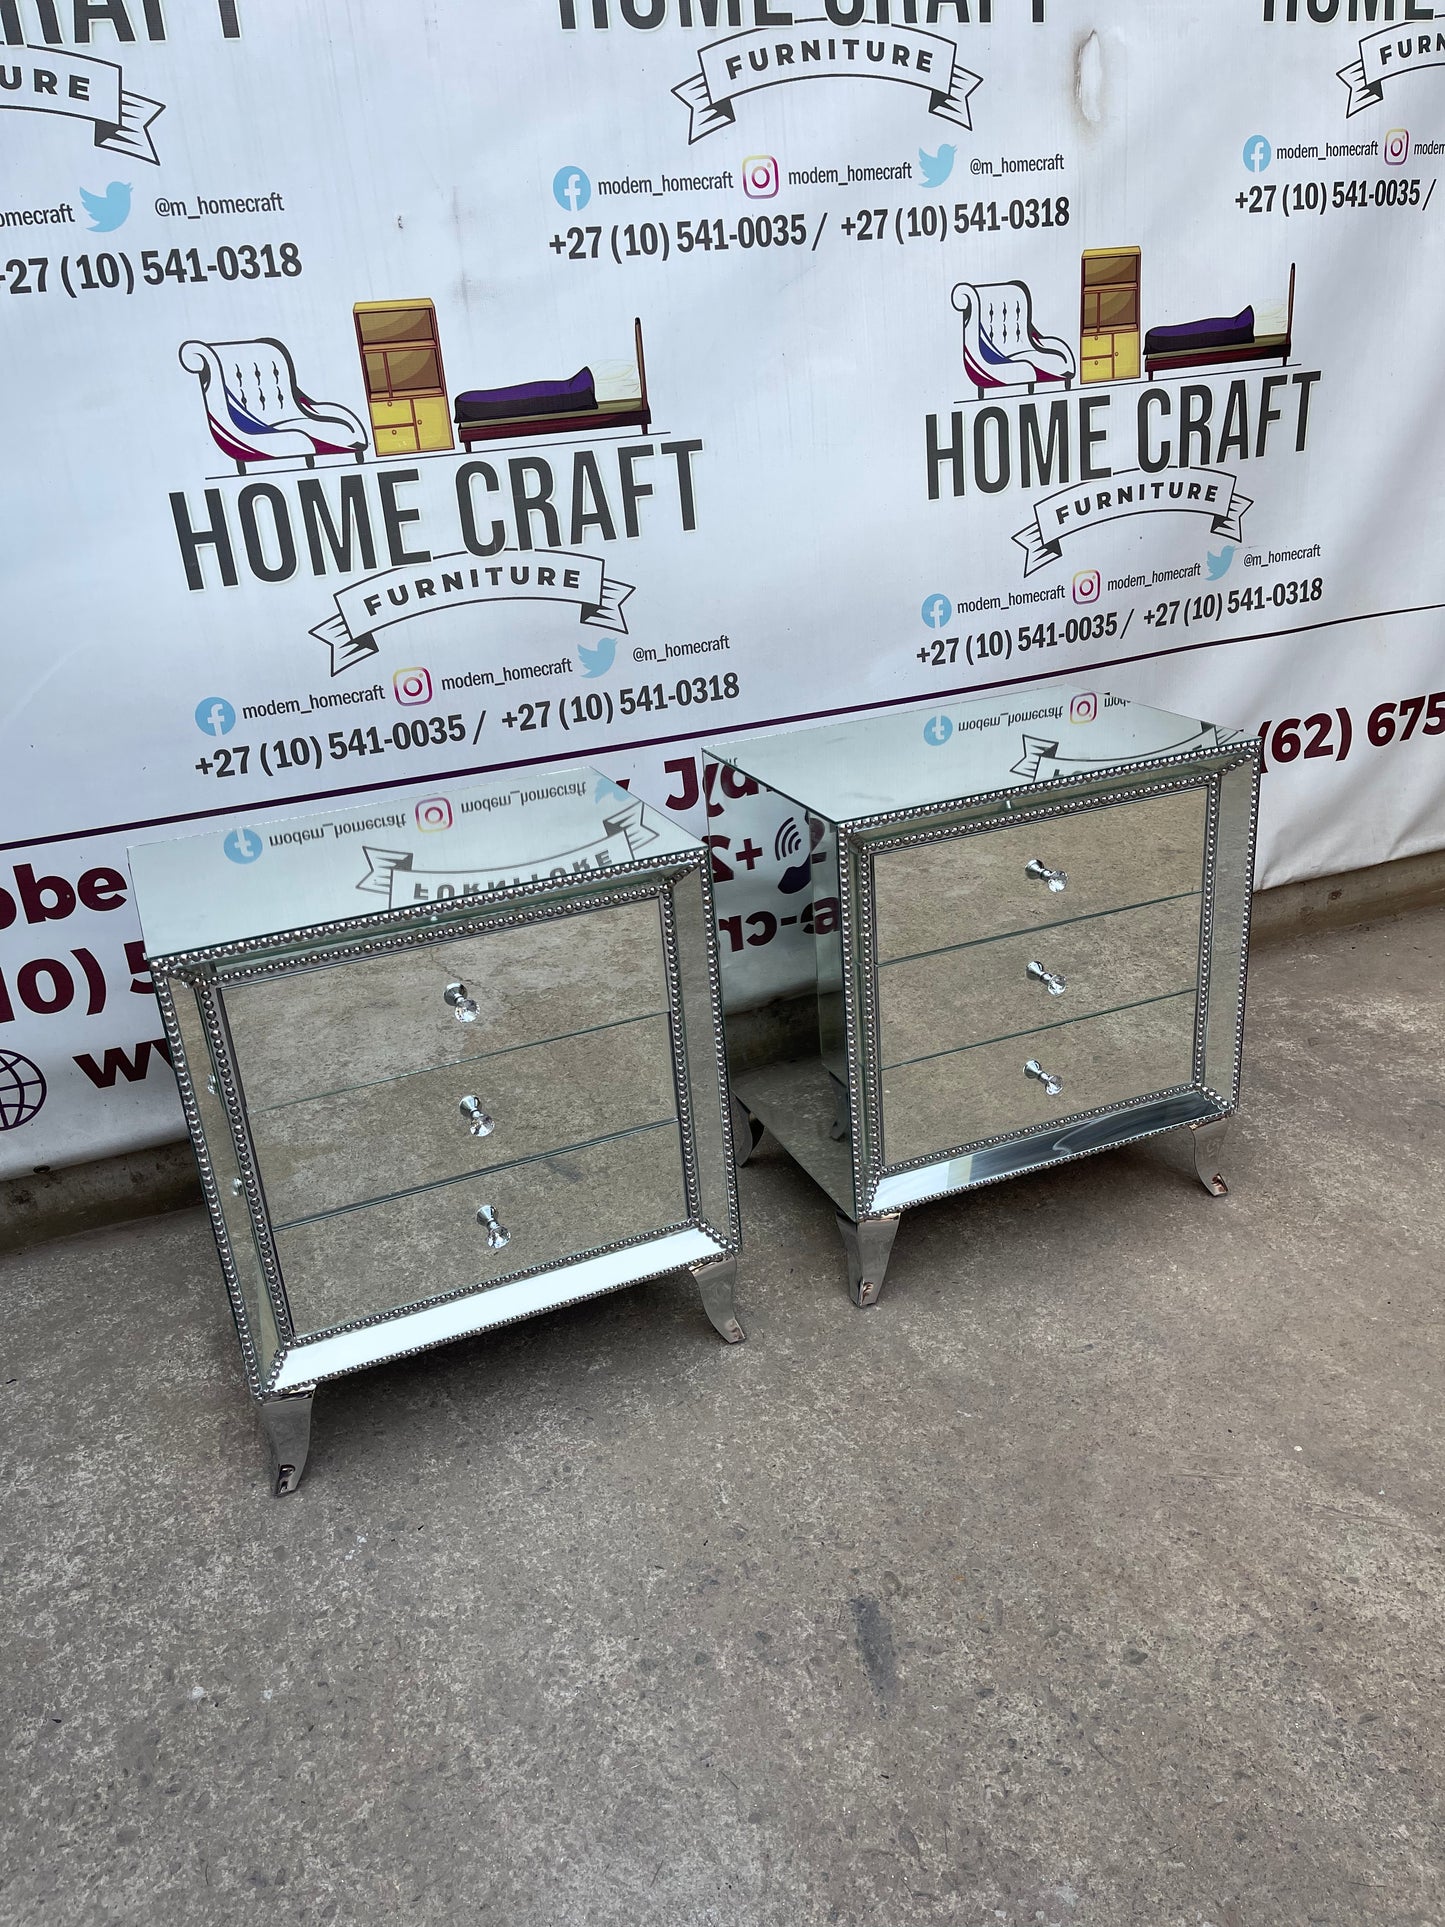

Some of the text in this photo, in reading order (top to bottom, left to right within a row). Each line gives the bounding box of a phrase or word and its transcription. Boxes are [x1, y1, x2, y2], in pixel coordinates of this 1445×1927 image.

[725, 38, 934, 81] FURNITURE
[598, 170, 734, 197] modern_homecraft
[788, 161, 912, 186] modern_homecraft
[969, 153, 1065, 178] @m_homecraft
[154, 192, 285, 220] @m_homecraft
[925, 370, 1322, 501] HOME CRAFT
[168, 438, 704, 591] HOME CRAFT
[1055, 481, 1220, 526] FURNITURE
[362, 565, 581, 617] FURNITURE
[956, 584, 1066, 616] modern_homecraft
[1107, 563, 1202, 592] modern_homecraft
[1243, 543, 1322, 569] @m_homecraft
[242, 683, 386, 720] modern_homecraft
[441, 658, 573, 691] modern_homecraft
[632, 634, 731, 664] @m_homecraft
